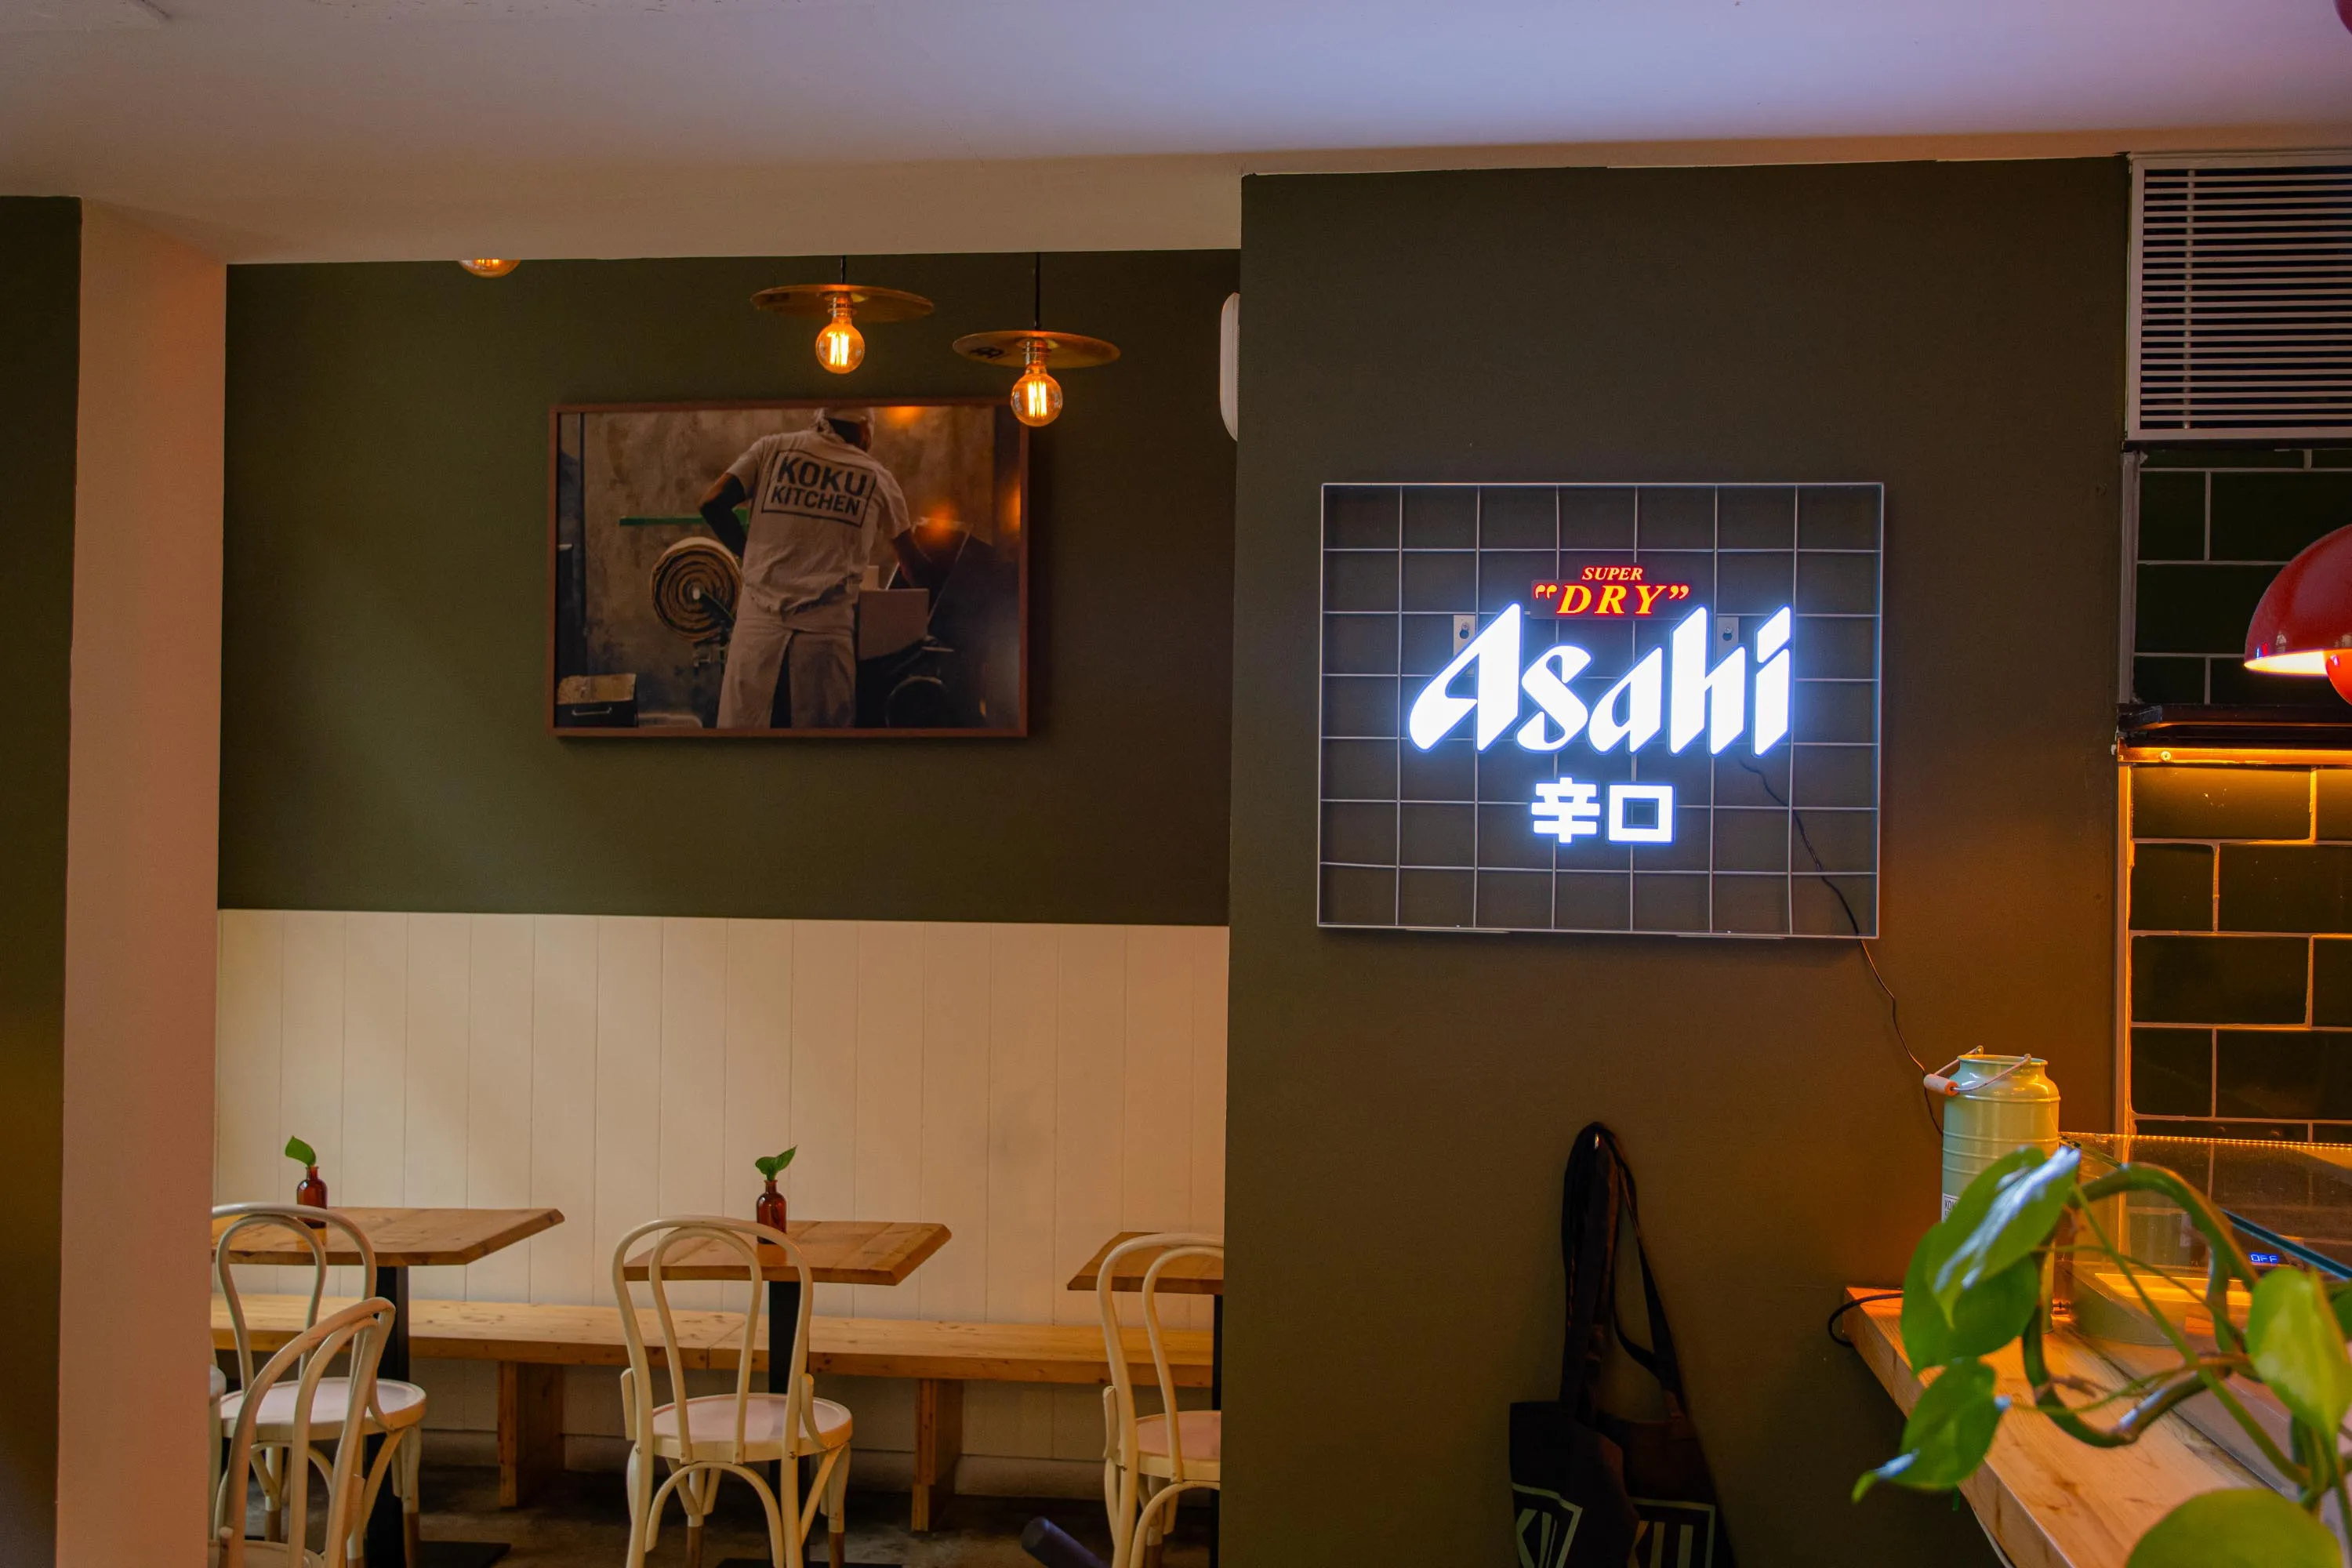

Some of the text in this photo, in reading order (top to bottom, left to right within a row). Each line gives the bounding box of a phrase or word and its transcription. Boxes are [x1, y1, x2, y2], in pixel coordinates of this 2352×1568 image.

[777, 455, 867, 496] KOKU
[771, 485, 862, 517] KITCHEN
[1581, 566, 1644, 582] SUPER
[1408, 601, 1792, 757] Asahi
[1530, 776, 1675, 845] 辛口
